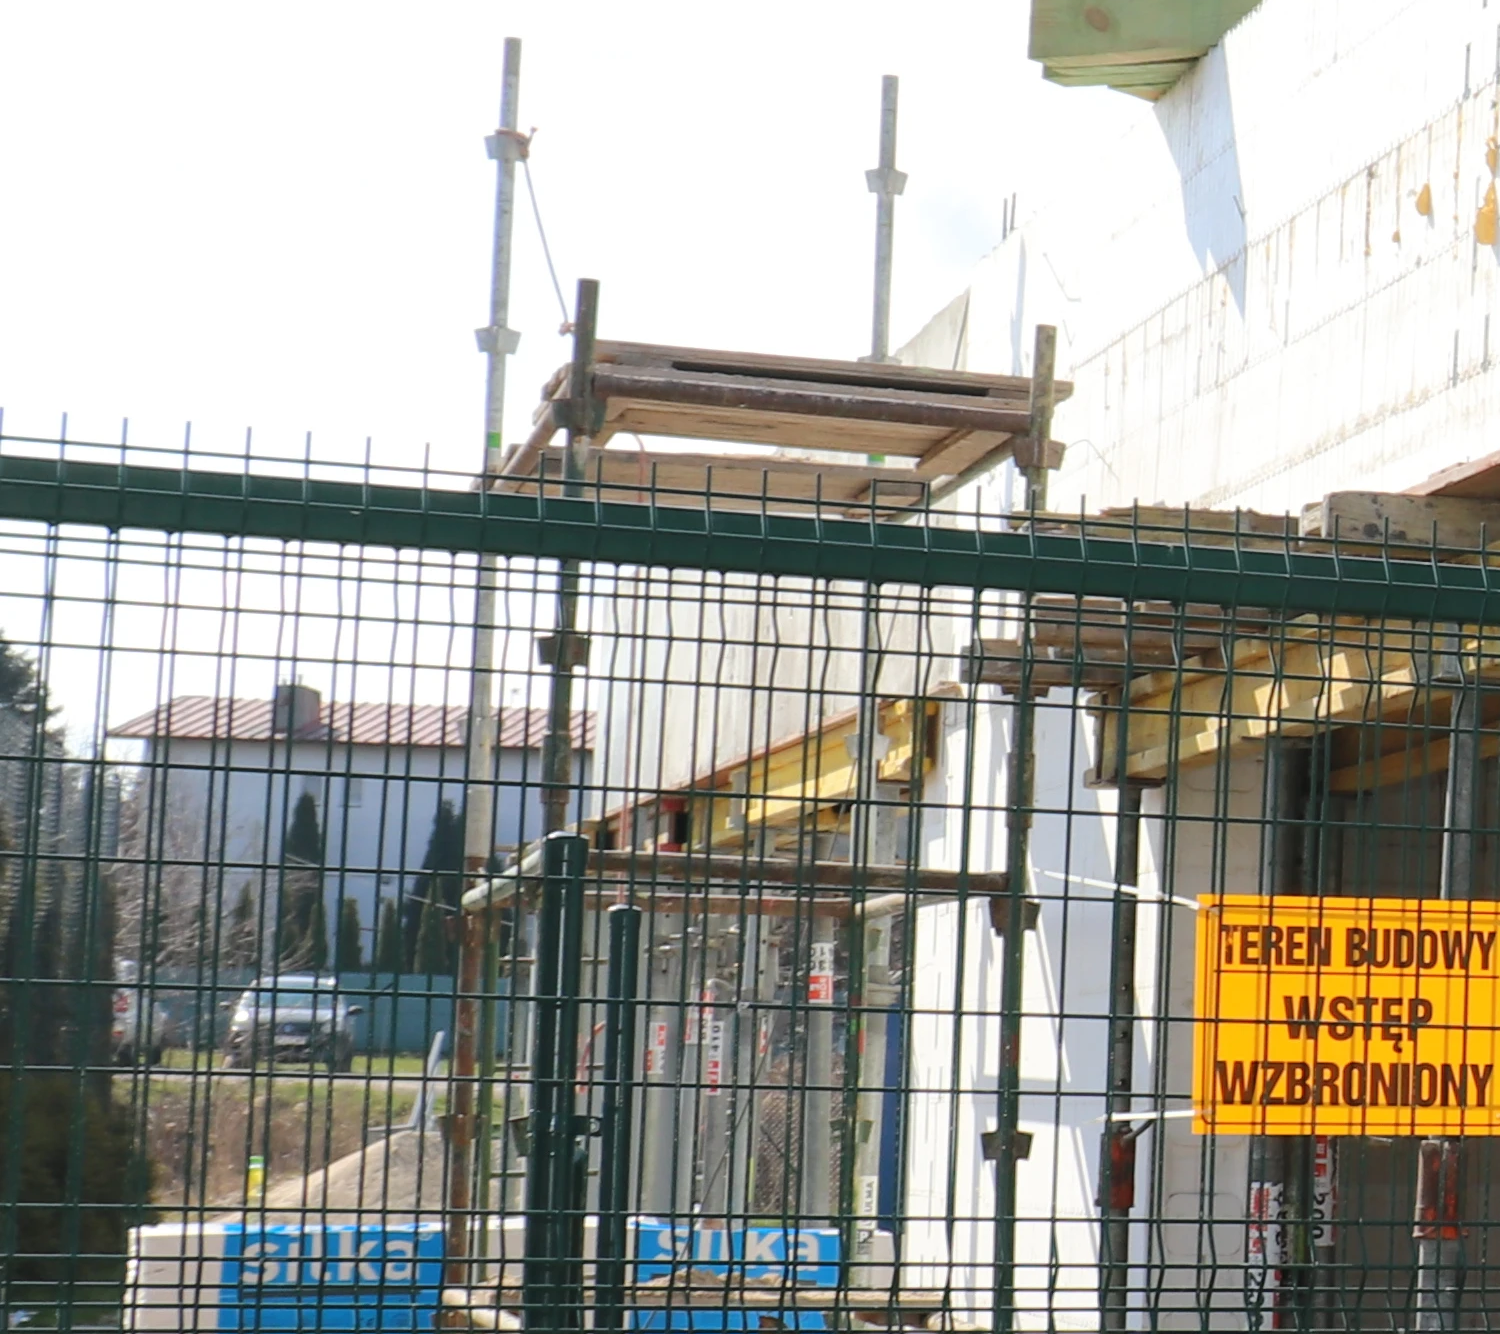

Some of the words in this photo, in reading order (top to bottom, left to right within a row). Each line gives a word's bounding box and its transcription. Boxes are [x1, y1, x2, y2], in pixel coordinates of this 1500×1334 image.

[1220, 925, 1332, 966] TEREN
[1345, 928, 1497, 970] BUDOWY
[1283, 995, 1434, 1054] WSTĘP
[1216, 1060, 1495, 1108] WZBRONIONY
